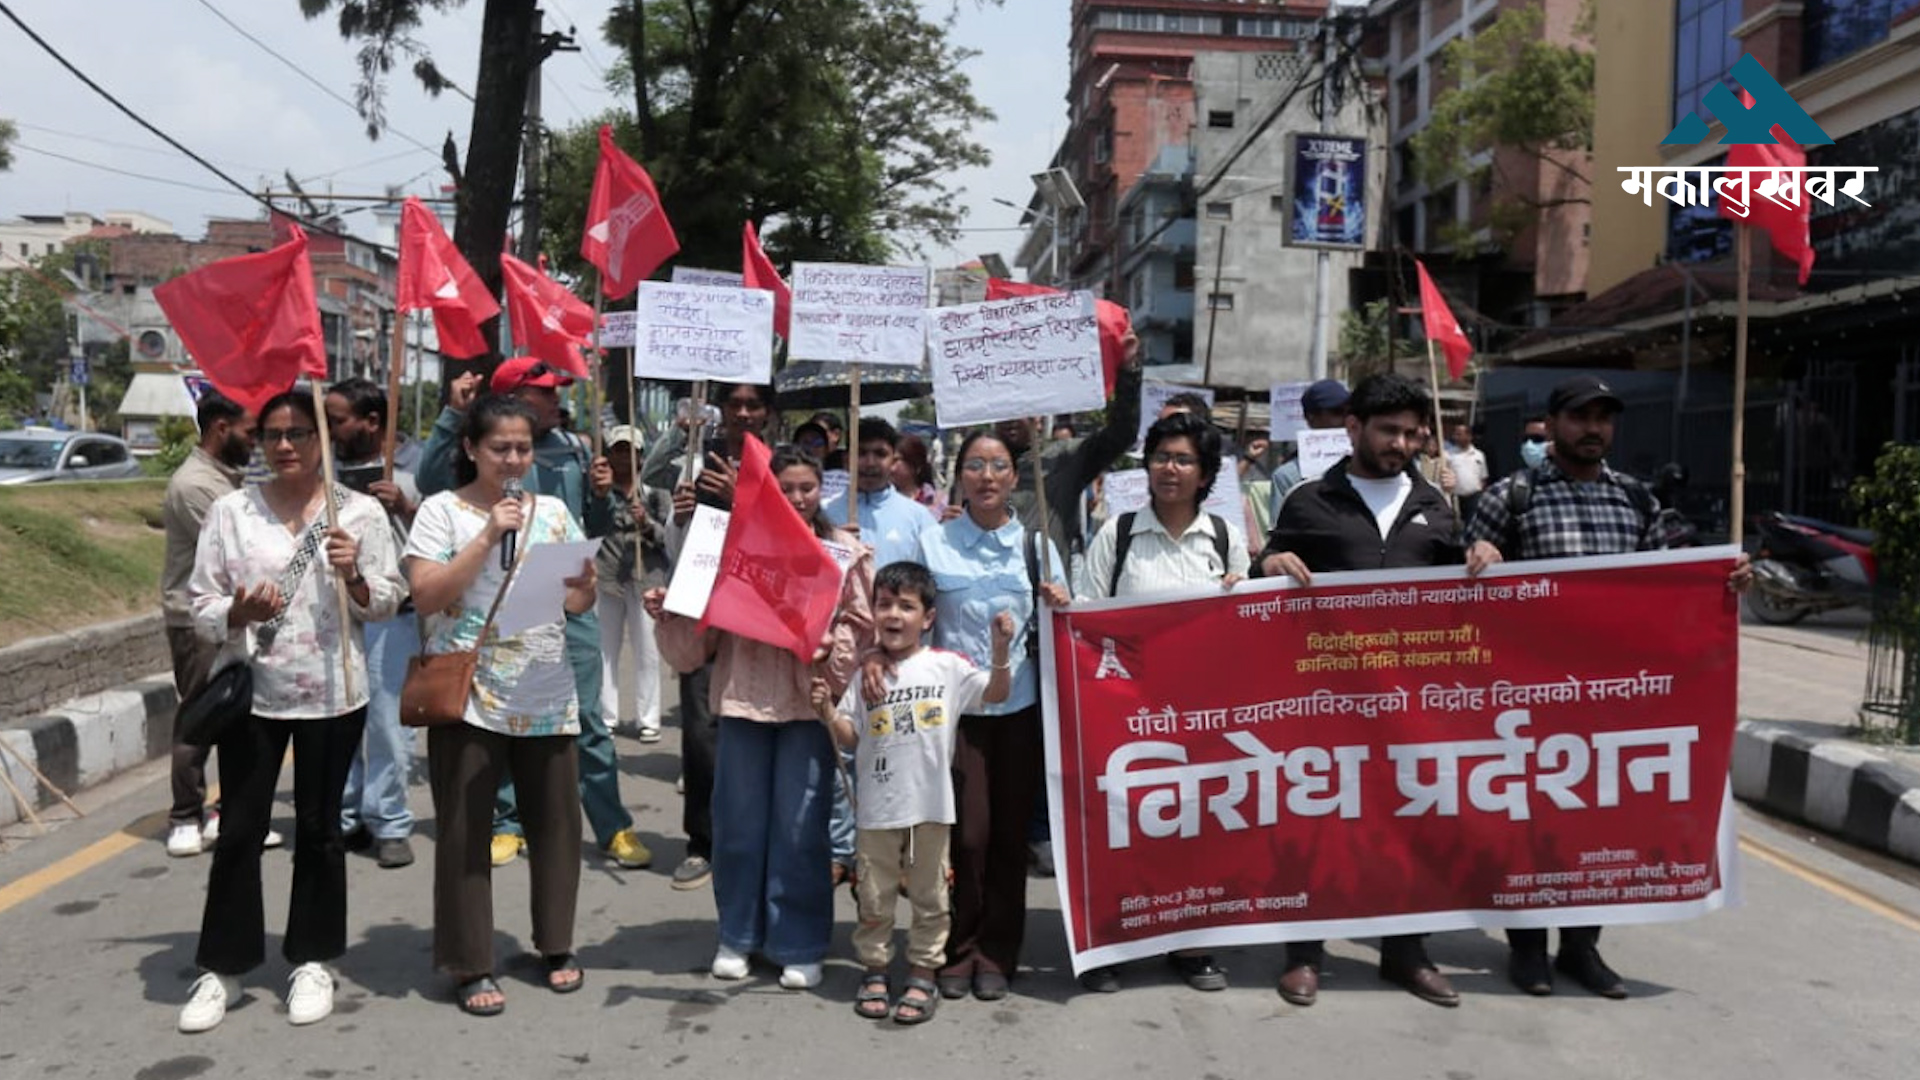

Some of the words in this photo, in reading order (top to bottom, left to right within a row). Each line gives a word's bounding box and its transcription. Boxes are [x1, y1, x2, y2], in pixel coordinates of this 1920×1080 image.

[1237, 596, 1281, 621] सम्पूर्ण
[1284, 597, 1312, 613] जात
[1315, 587, 1418, 609] व्यवस्थाविरोधी
[1487, 586, 1513, 601] एक
[1126, 705, 1180, 736] पाँचौ
[1183, 708, 1228, 732] जात
[1233, 685, 1410, 725] व्यवस्थाविरुद्धको
[1420, 682, 1485, 712] विद्रोह
[1491, 674, 1582, 708] दिवसको
[1586, 669, 1673, 700] सन्दर्भमा
[1097, 731, 1369, 849] विरोध
